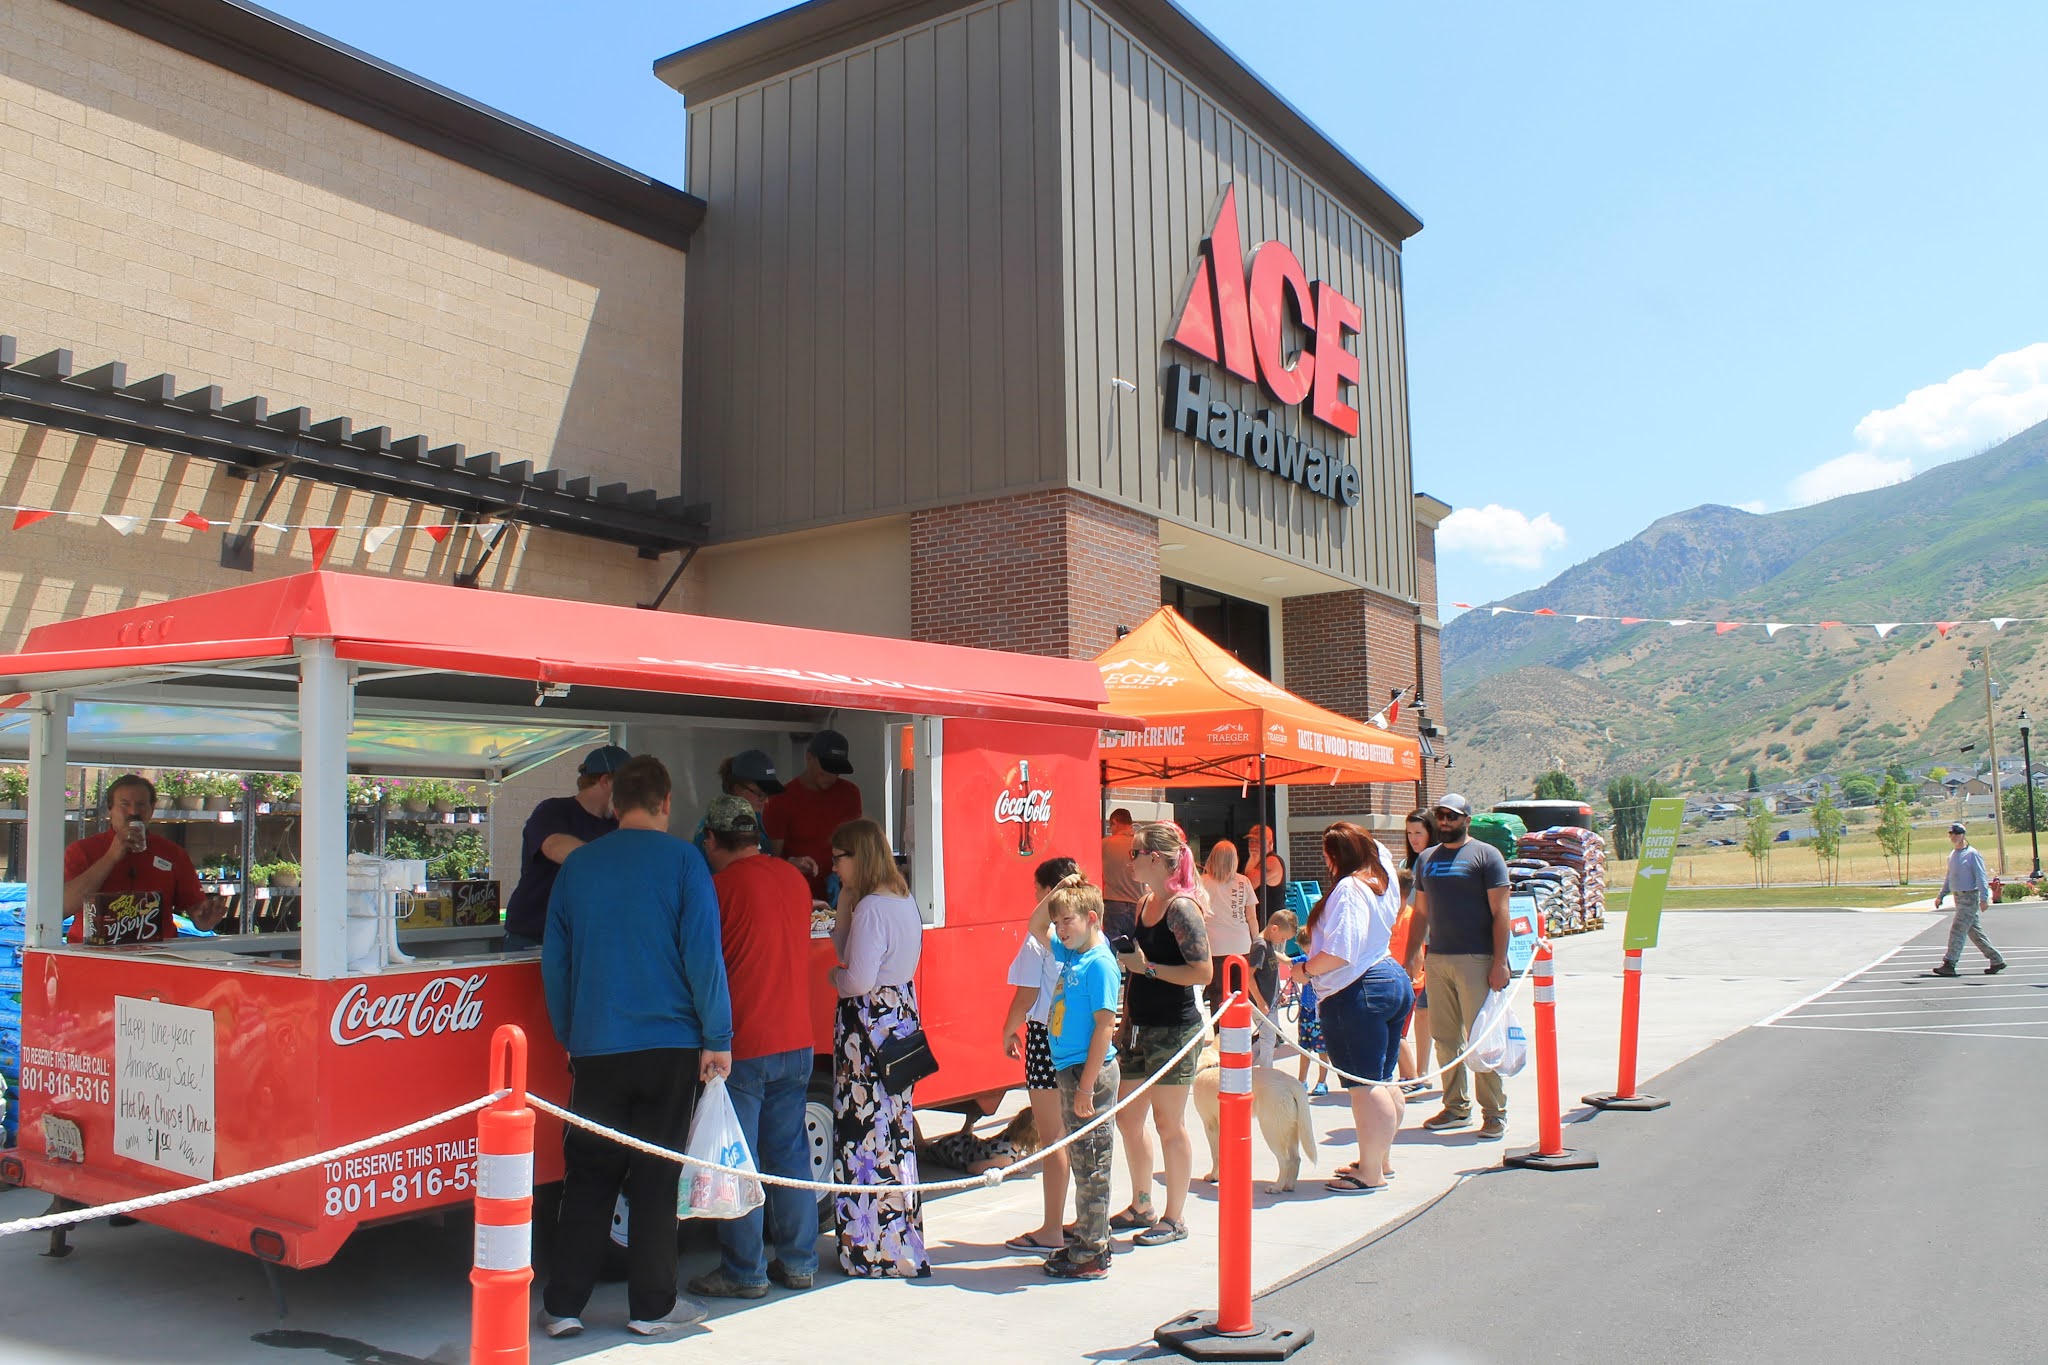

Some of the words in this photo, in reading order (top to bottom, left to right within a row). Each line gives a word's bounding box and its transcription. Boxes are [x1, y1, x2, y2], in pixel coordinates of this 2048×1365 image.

[1165, 182, 1362, 438] ACE
[1165, 364, 1360, 507] Hardware
[1120, 726, 1185, 748] DIFFERENCE
[1207, 733, 1249, 742] TRAEGER
[1267, 732, 1288, 744] TRAEGER
[1297, 729, 1313, 751] TASTE
[1313, 732, 1324, 753] THE
[1323, 734, 1347, 757] WOOD
[1348, 740, 1369, 761] FIRED
[1369, 743, 1395, 765] DIFFERENCE
[995, 789, 1054, 824] Coca-Cola
[1644, 847, 1670, 858] HERE
[1645, 836, 1675, 847] ENTER
[456, 881, 496, 911] Shasta
[104, 908, 160, 945] Shasta
[120, 1003, 146, 1050] Happy
[330, 973, 488, 1046] Coca-Cola
[22, 1046, 31, 1063] TO
[31, 1047, 54, 1067] RESERVE
[54, 1051, 67, 1070] THIS
[67, 1053, 92, 1073] TRAILER
[92, 1057, 110, 1076] CALL:
[123, 1046, 172, 1092] Anniversary
[173, 1057, 205, 1092] Sale!
[22, 1066, 110, 1104] 801-816-5316
[121, 1089, 137, 1119] Hot
[154, 1094, 177, 1129] Chips
[187, 1103, 212, 1134] Drink
[324, 1161, 342, 1183] TO
[345, 1150, 403, 1180] RESERVE
[406, 1145, 433, 1169] THIS
